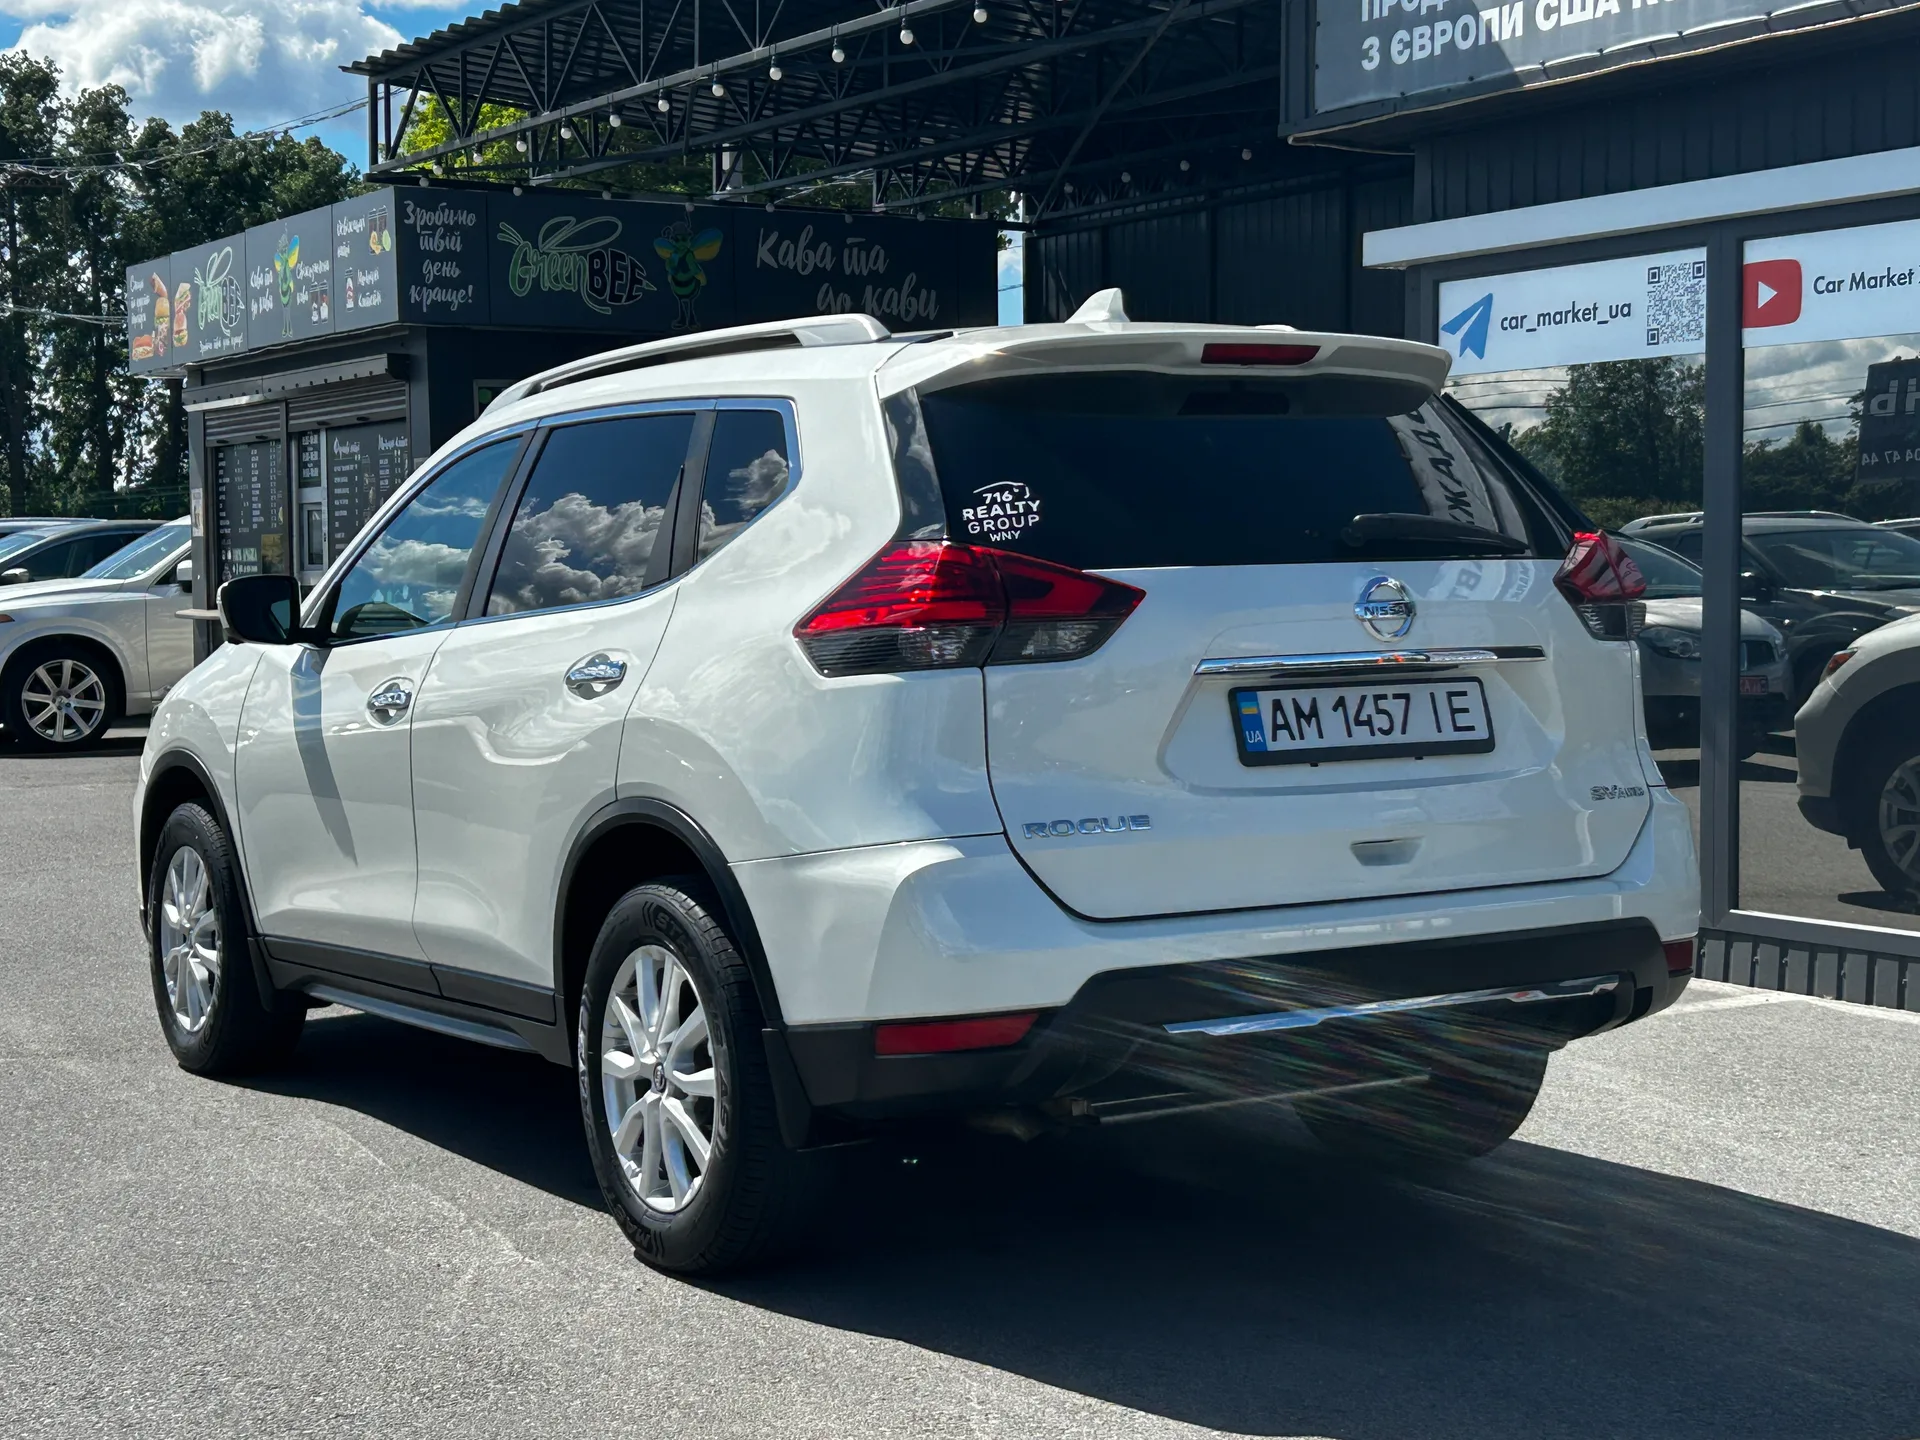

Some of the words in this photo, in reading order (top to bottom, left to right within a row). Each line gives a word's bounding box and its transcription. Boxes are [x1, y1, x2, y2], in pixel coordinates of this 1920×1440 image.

[1390, 1, 1524, 65] ЄВРОПИ
[404, 199, 477, 233] Зробимо
[756, 224, 836, 276] Кава
[422, 257, 462, 284] день
[1813, 275, 1845, 295] Car
[1848, 266, 1915, 292] Market
[409, 284, 475, 313] краще!
[861, 272, 941, 322] кави
[1500, 300, 1632, 333] car_market_ua
[962, 500, 1040, 521] REALTY
[982, 490, 1013, 504] 716
[967, 514, 1040, 534] GROUP
[989, 530, 1021, 542] WNY
[1270, 696, 1325, 743] AM
[1332, 692, 1412, 738] 1457
[1429, 690, 1476, 733] IE
[1245, 730, 1264, 744] UA
[1022, 814, 1152, 840] ROGUE
